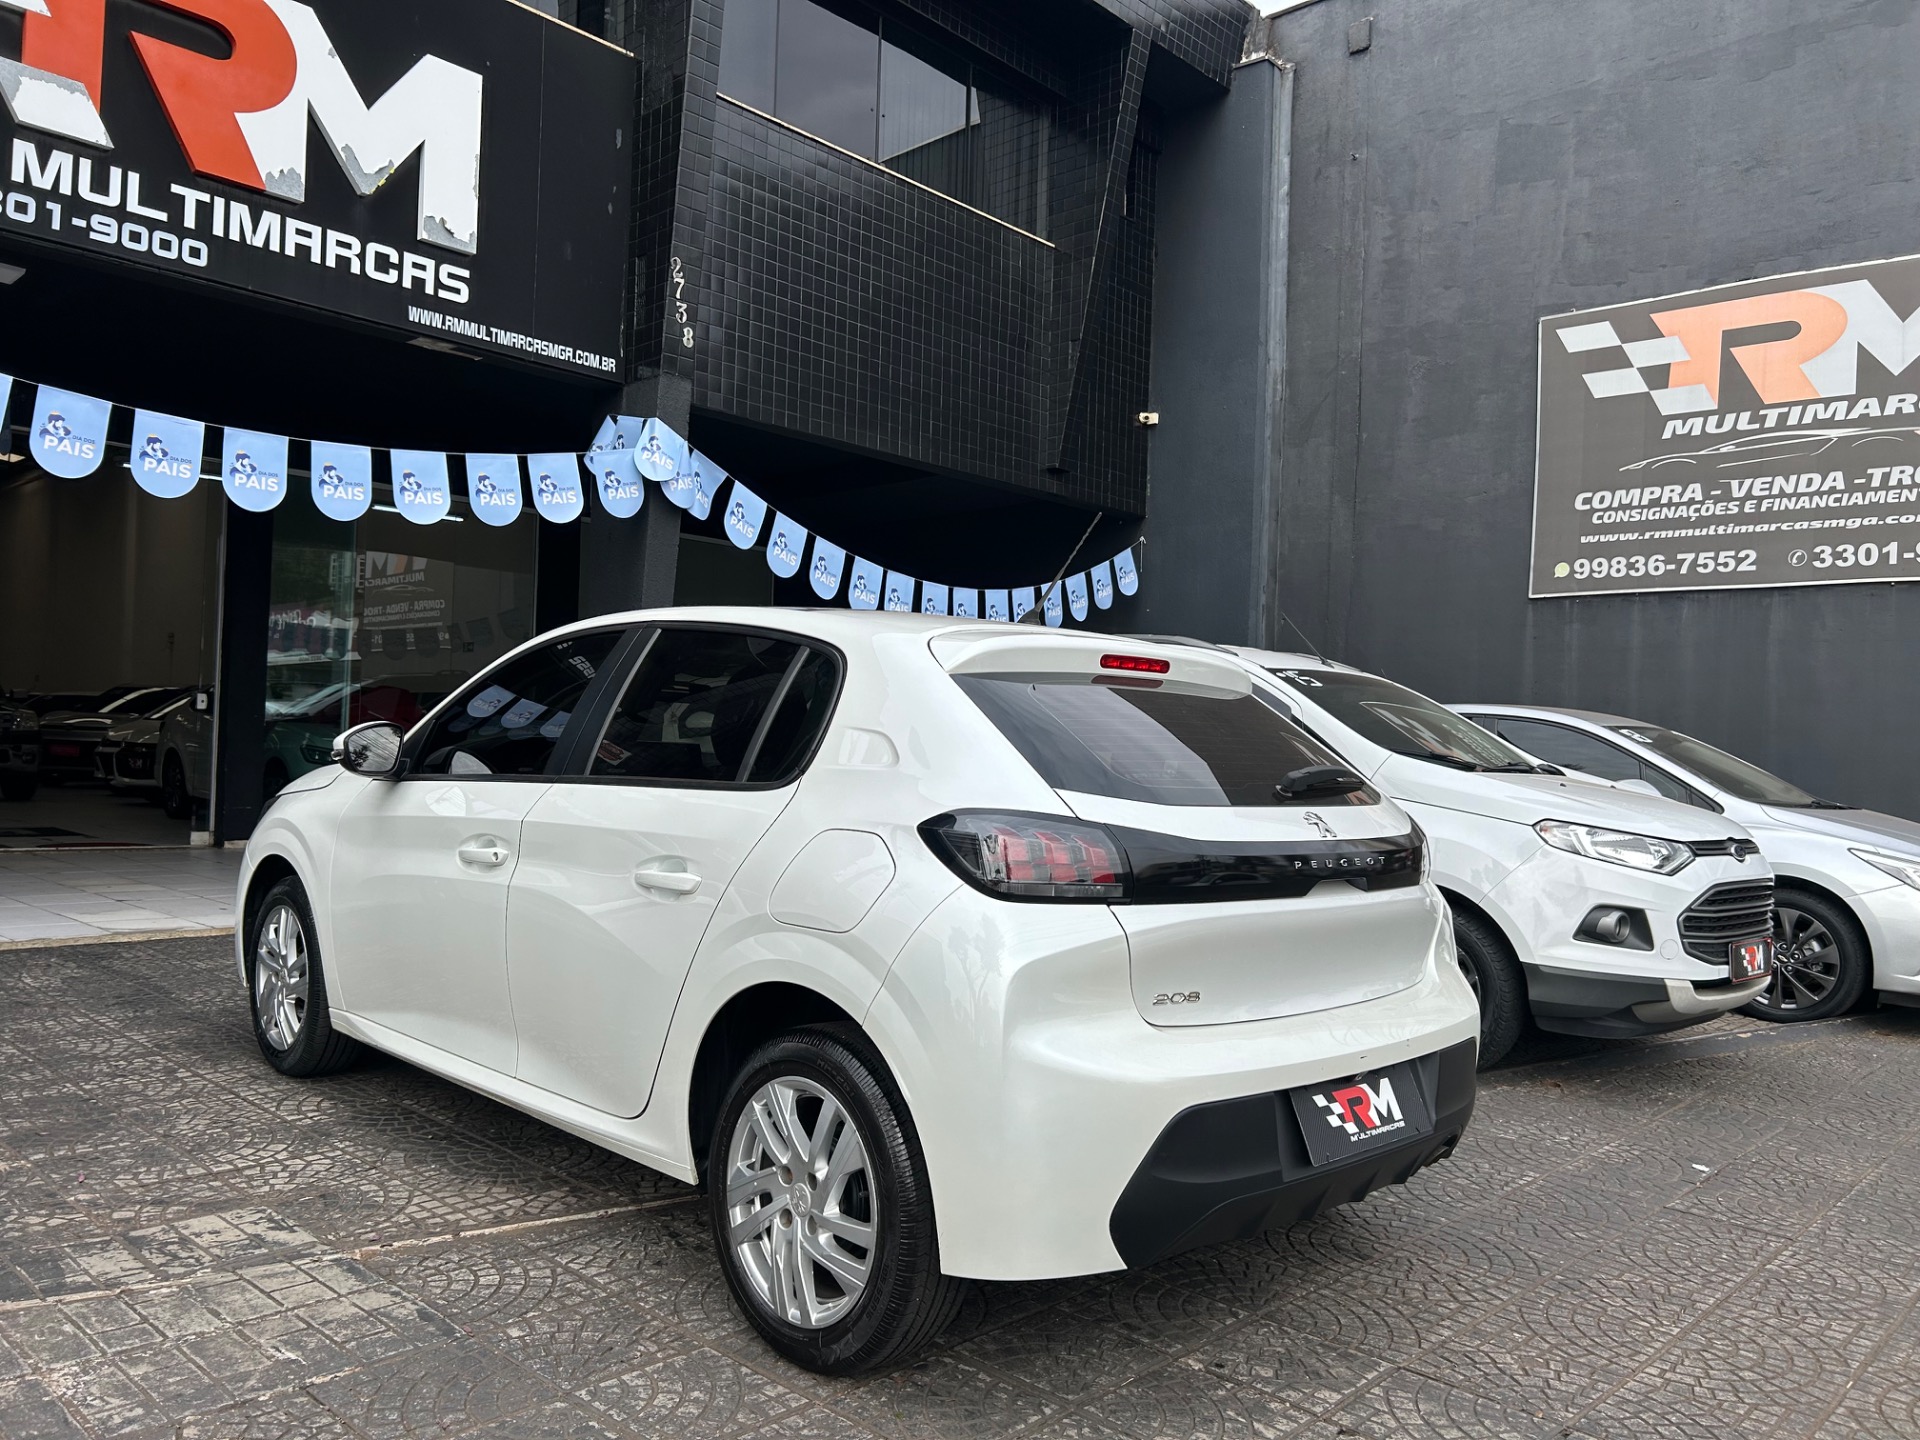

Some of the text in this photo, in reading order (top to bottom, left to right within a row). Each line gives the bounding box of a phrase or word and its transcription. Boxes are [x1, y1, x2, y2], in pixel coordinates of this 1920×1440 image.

[0, 190, 209, 268] 01-9000
[11, 137, 471, 304] MULTIMARCAS
[670, 256, 694, 348] 2738
[408, 305, 616, 373] WWW.RMMULTIMARCASMGA.COM.BR
[1662, 393, 1920, 440] MULTIMAR
[43, 434, 95, 460] PAIS
[72, 434, 83, 442] DIA
[143, 456, 192, 479] PAIS
[641, 451, 674, 471] PAIS
[234, 473, 279, 492] PAIS
[323, 484, 364, 501] PAIS
[669, 477, 693, 492] PAIS
[1574, 483, 1703, 511] COMPRA
[1718, 470, 1846, 498] VENDA
[404, 491, 444, 505] PAIS
[479, 492, 516, 506] PAIS
[542, 491, 577, 505] PAIS
[608, 486, 639, 501] PAIS
[1592, 488, 1920, 524] CONSIGNAÇÕES E FINANCIAMEN
[730, 515, 755, 539] PAIS
[773, 547, 797, 566] PAIS
[1573, 549, 1757, 579] 99836-7552
[1812, 541, 1920, 568] 3301-
[815, 570, 836, 588] PAIS
[854, 588, 876, 605] PAIS
[1294, 857, 1385, 869] PEUGEOT
[1152, 991, 1201, 1006] 208
[1331, 1077, 1404, 1129] RM
[1350, 1120, 1406, 1142] MULTIMARCAS
